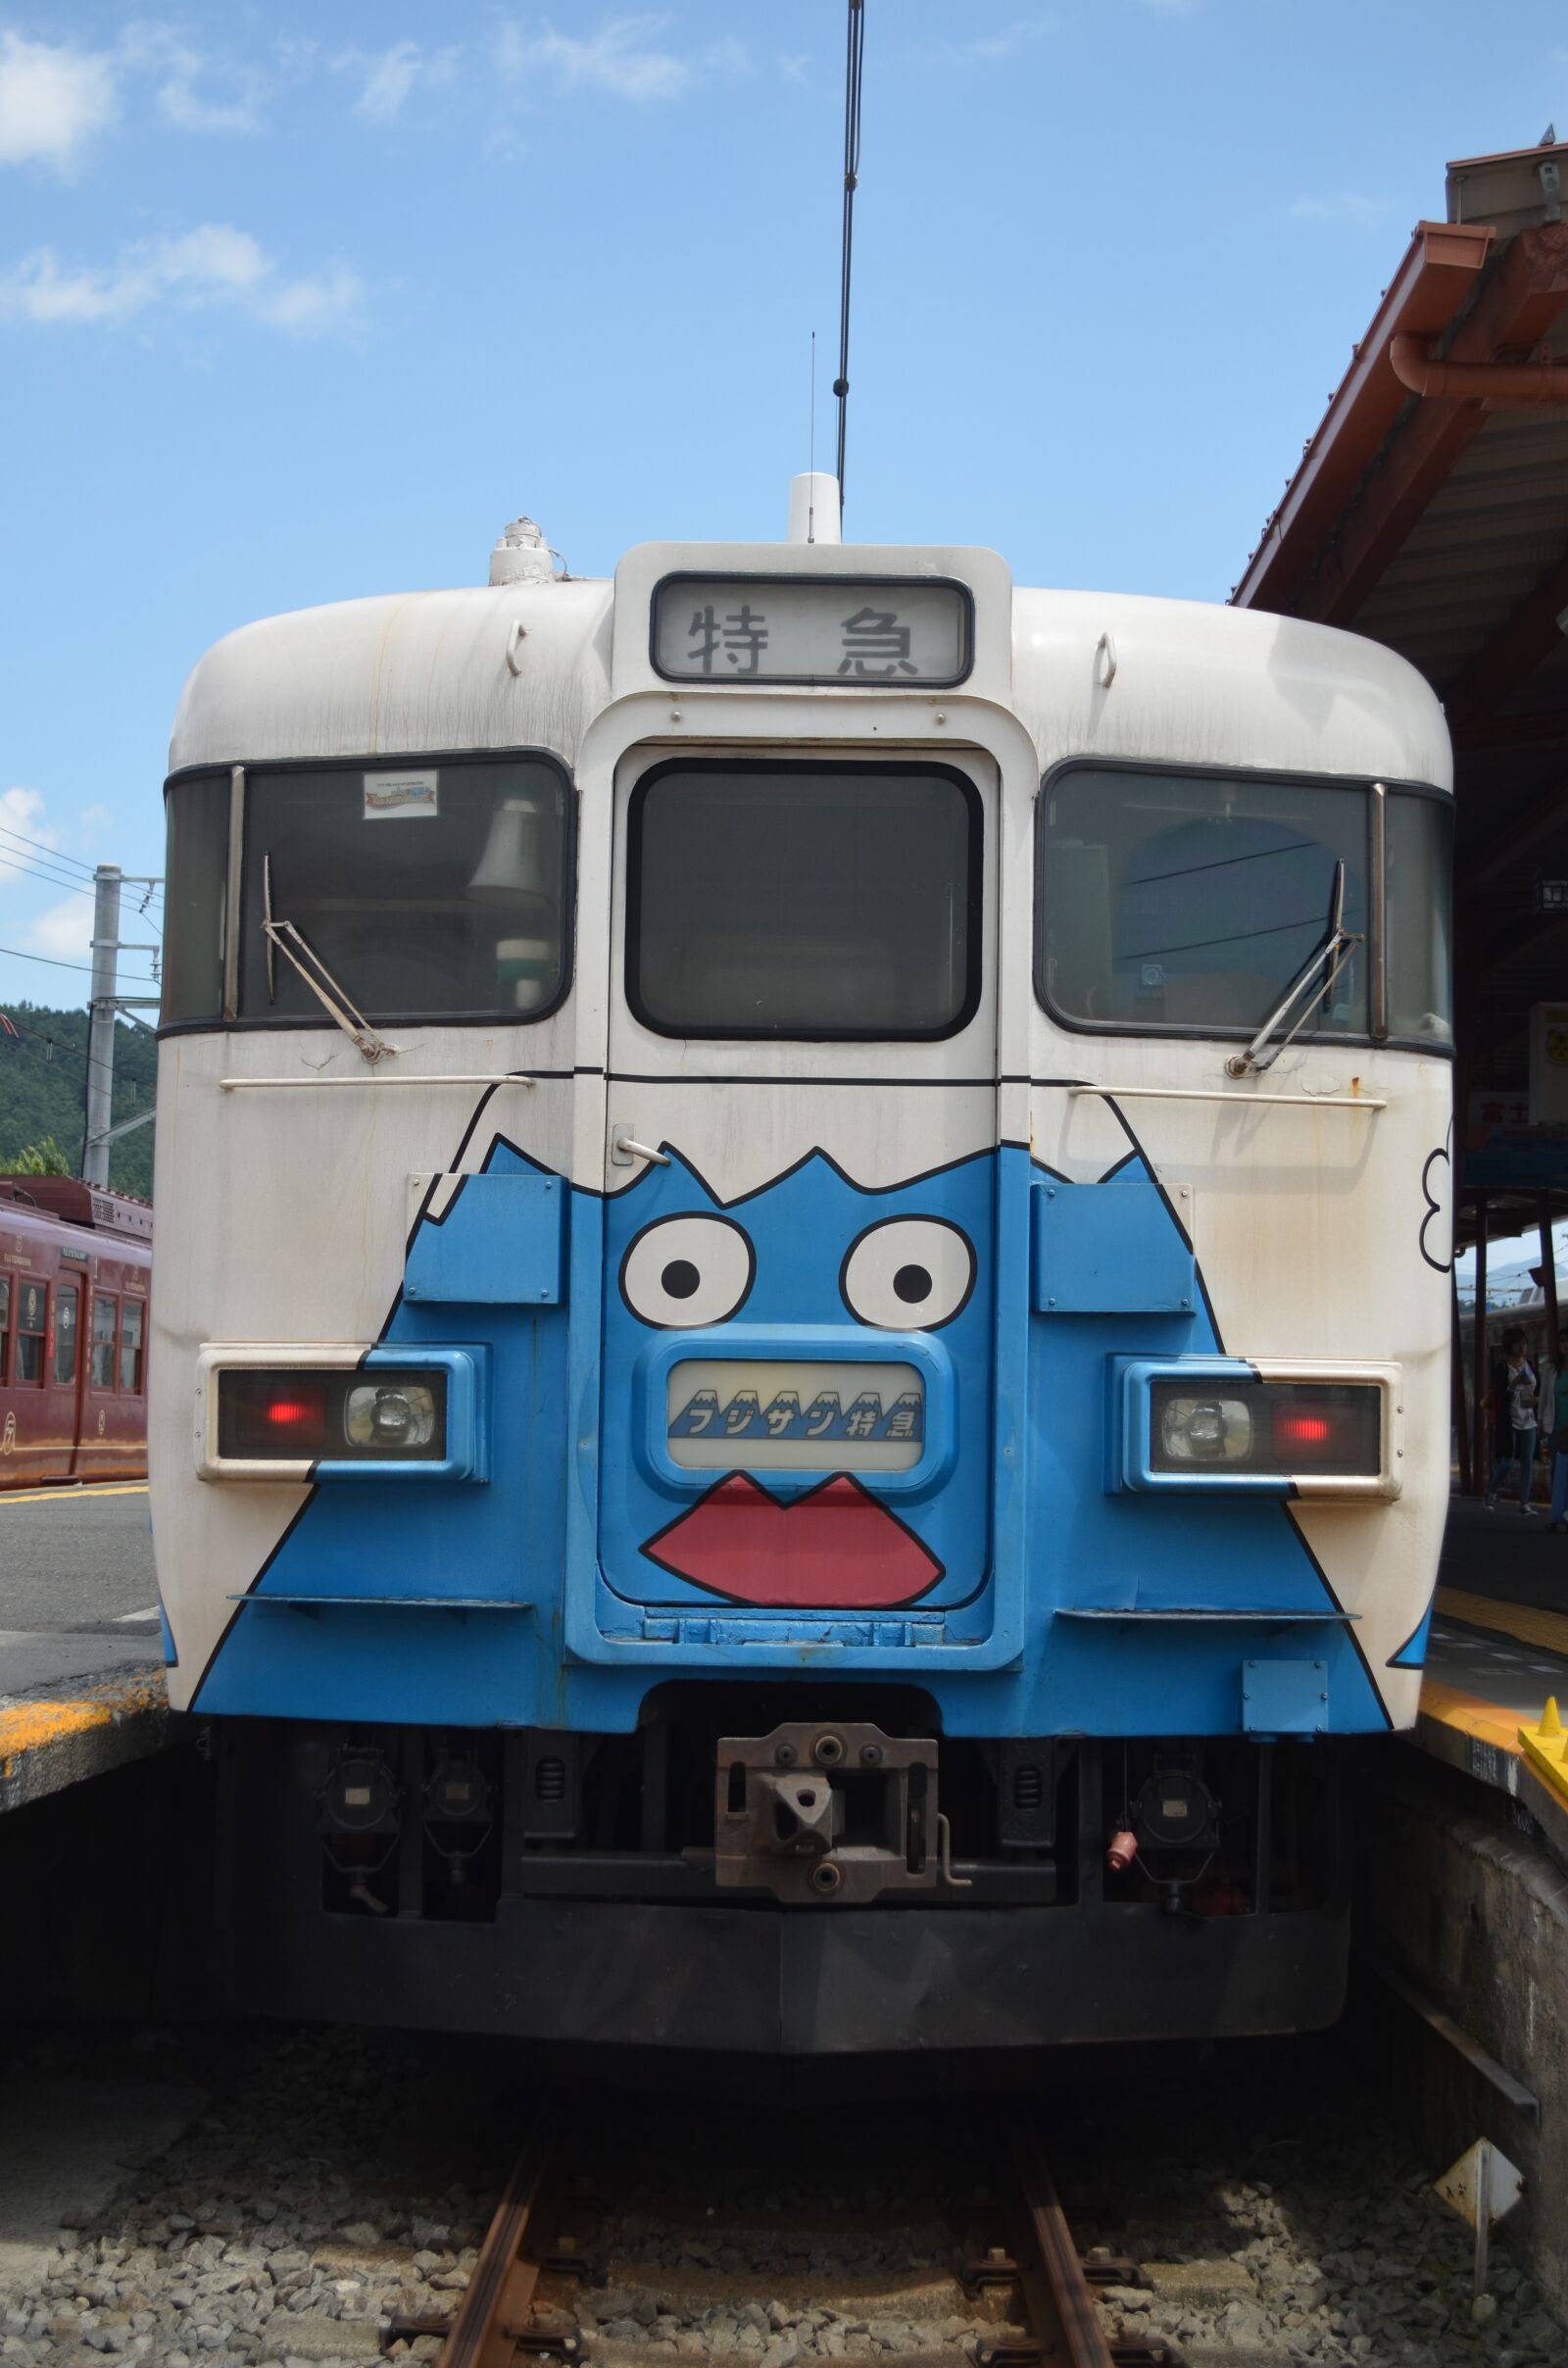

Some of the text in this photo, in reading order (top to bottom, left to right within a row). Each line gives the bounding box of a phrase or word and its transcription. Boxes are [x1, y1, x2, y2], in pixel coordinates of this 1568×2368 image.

[687, 605, 919, 676] 特急
[689, 1408, 916, 1437] フジサン特急
